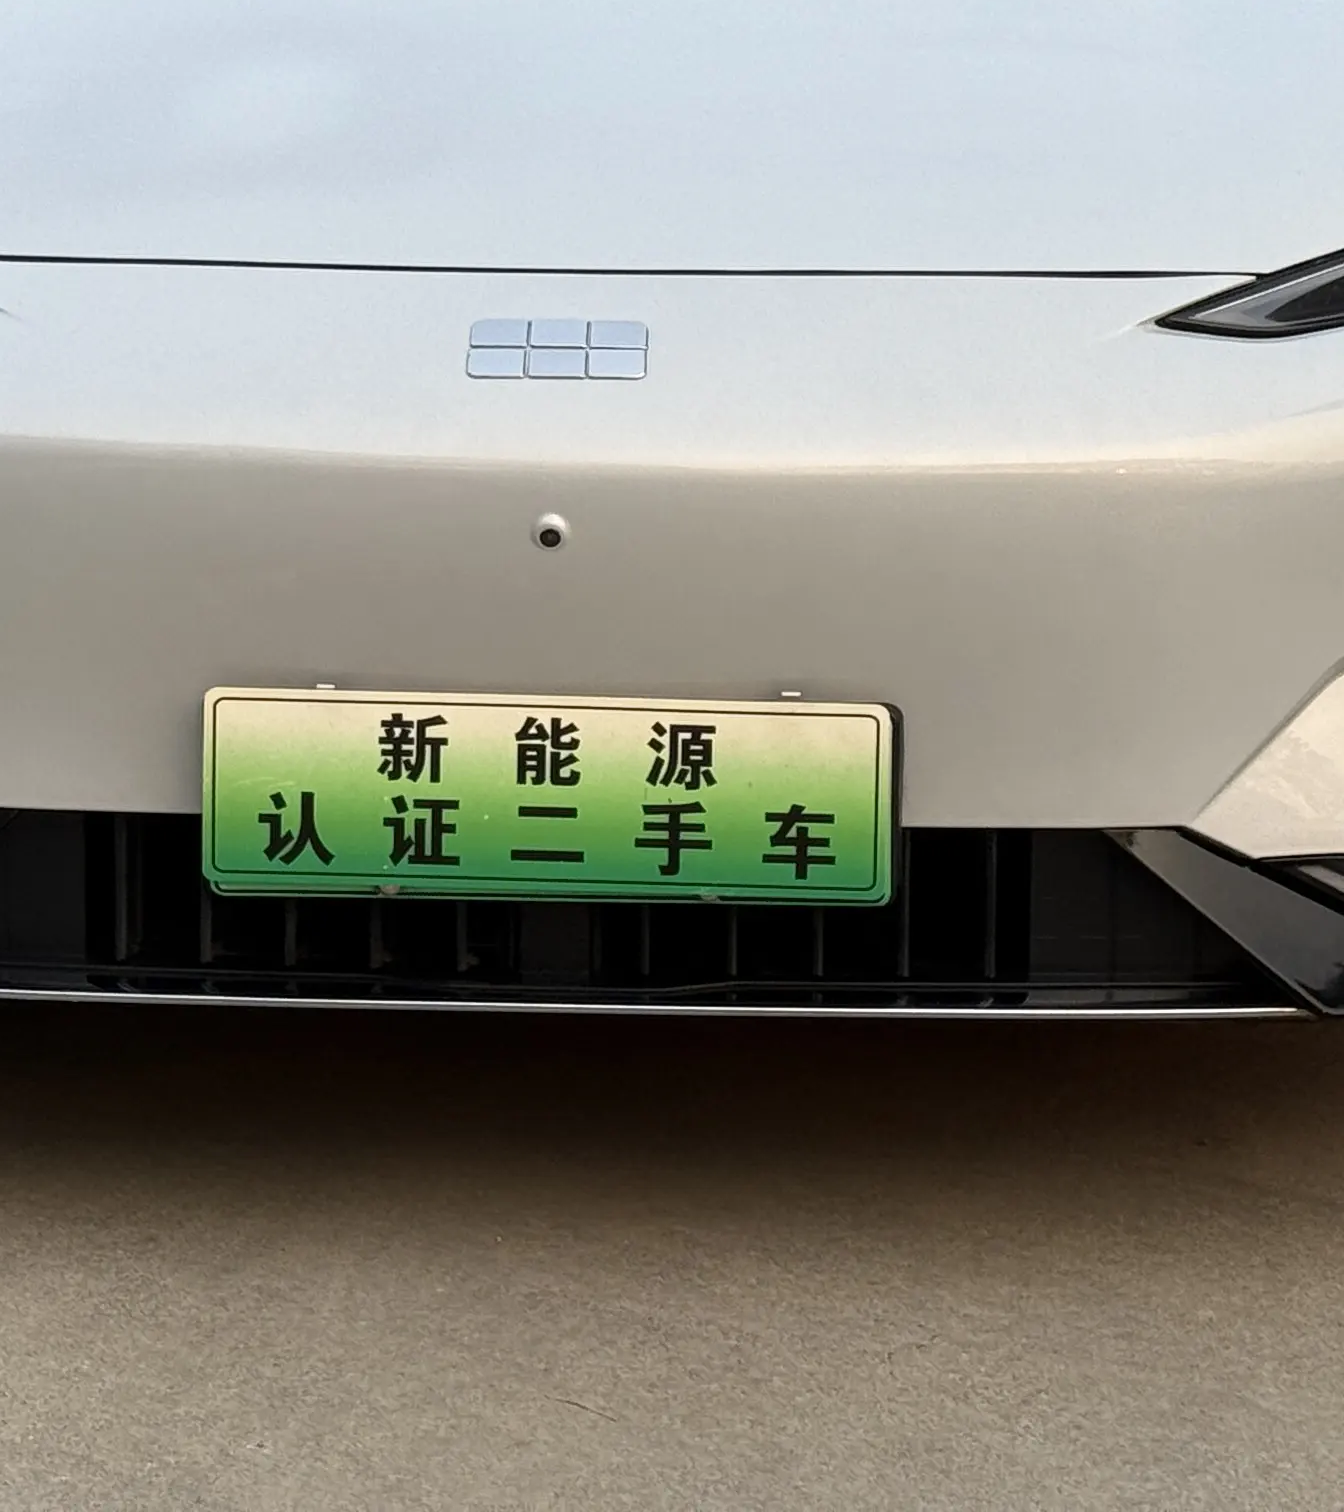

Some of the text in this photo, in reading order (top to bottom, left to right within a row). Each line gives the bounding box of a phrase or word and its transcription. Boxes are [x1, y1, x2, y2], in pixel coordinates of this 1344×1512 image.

[377, 712, 718, 792] 新能源
[257, 790, 837, 881] 认证二手车
